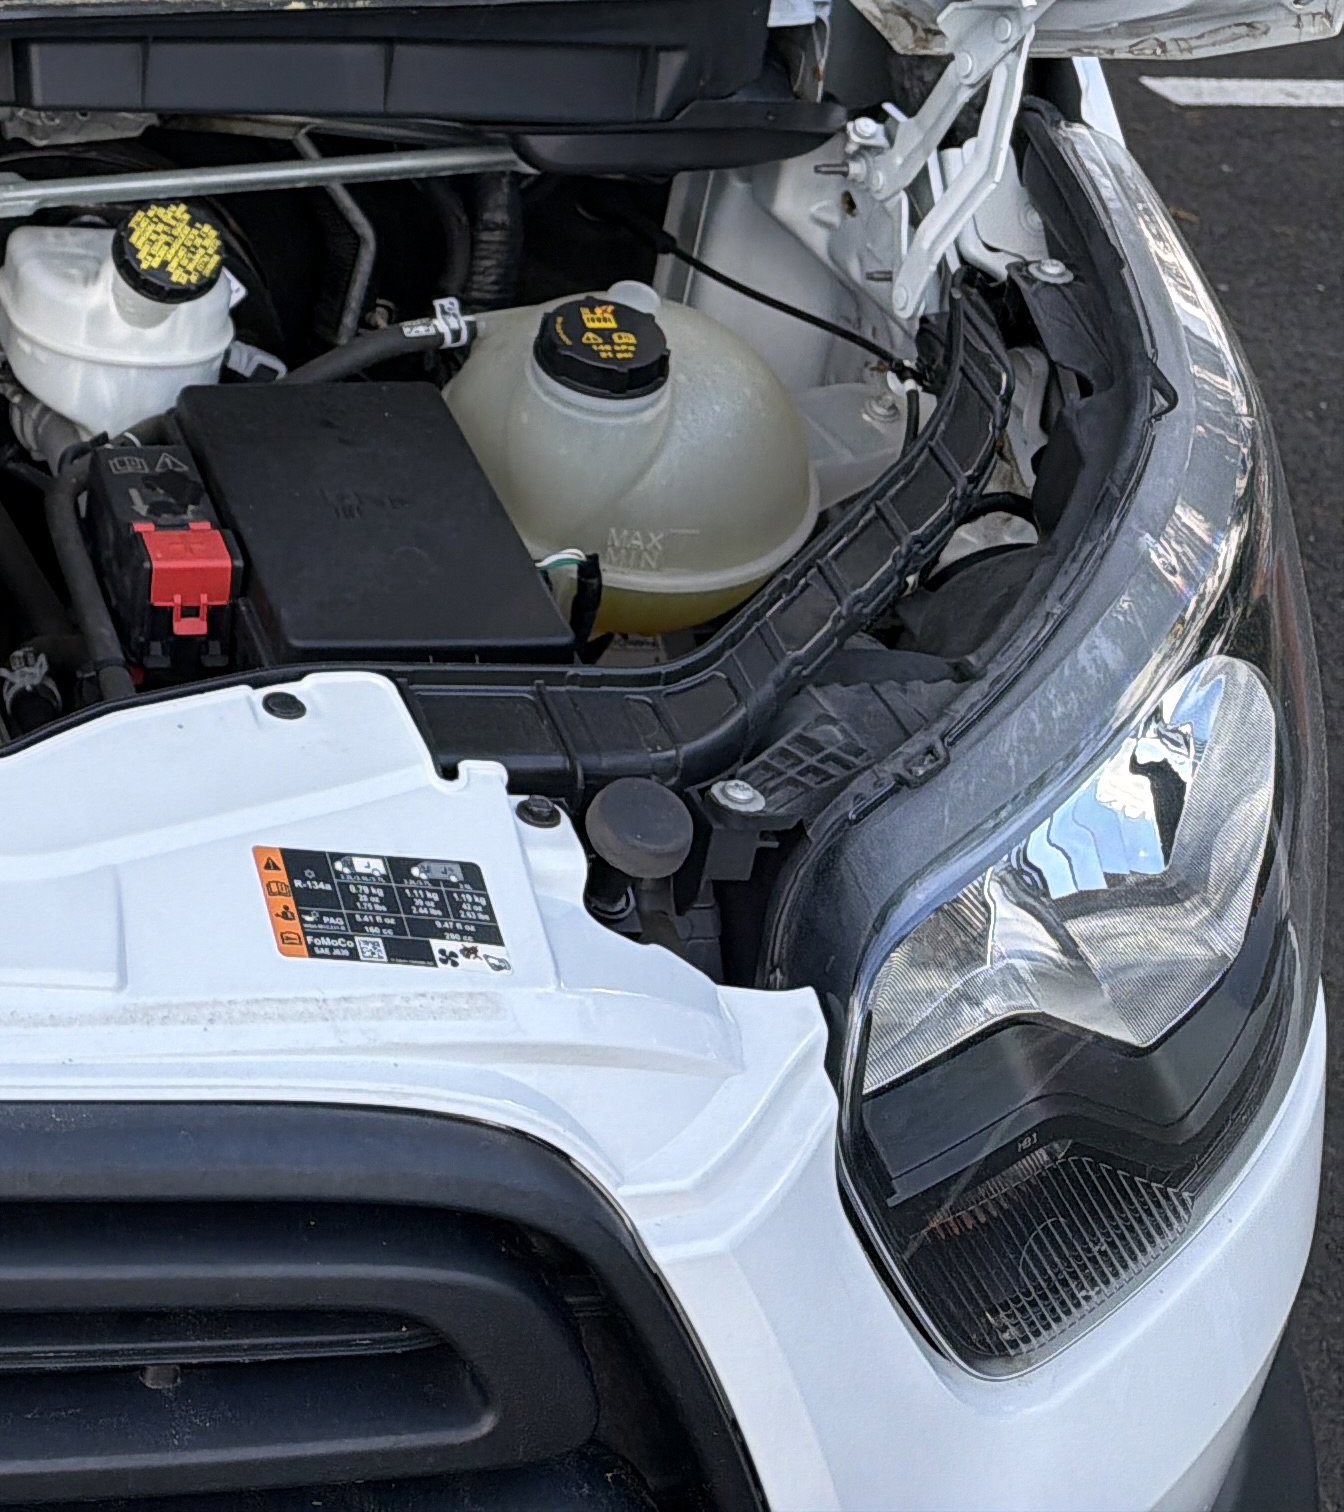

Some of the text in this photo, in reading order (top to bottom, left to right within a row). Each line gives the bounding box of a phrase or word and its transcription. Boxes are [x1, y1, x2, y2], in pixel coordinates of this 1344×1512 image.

[607, 528, 664, 551] MAX
[607, 547, 660, 569] MIN
[293, 879, 332, 890] R-134a
[371, 886, 384, 897] kg
[306, 936, 354, 948] FoMoCo
